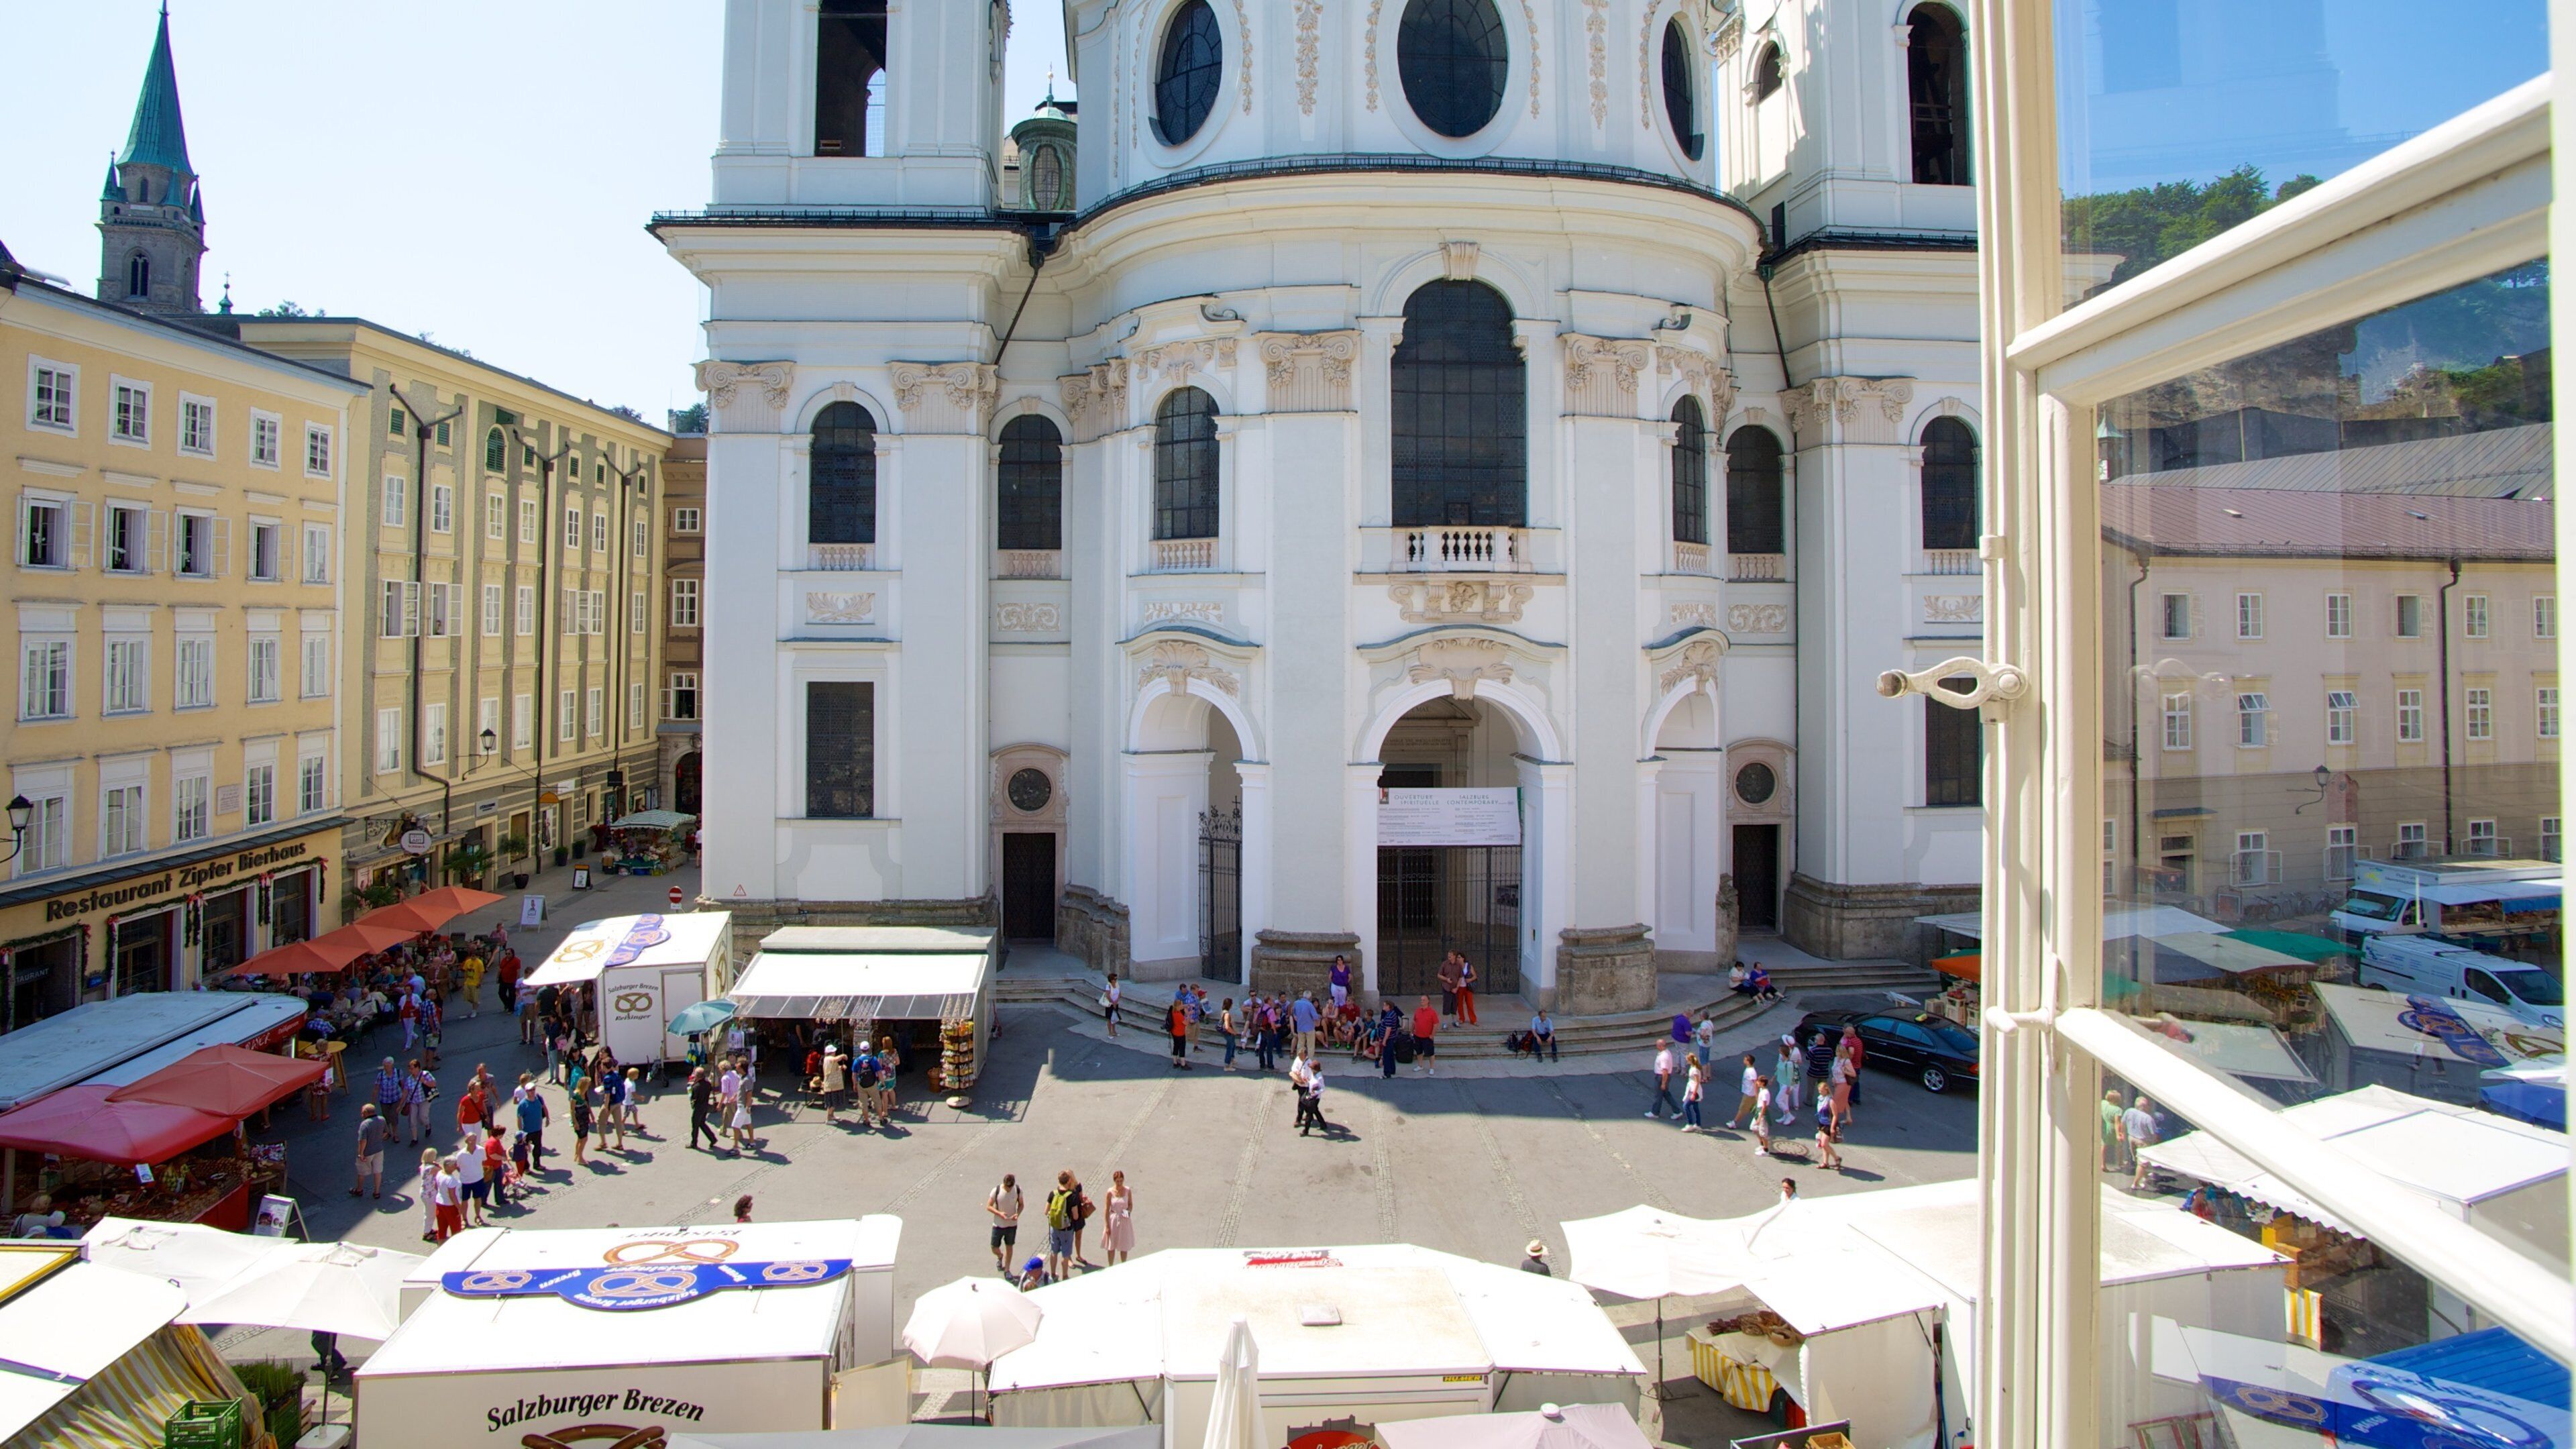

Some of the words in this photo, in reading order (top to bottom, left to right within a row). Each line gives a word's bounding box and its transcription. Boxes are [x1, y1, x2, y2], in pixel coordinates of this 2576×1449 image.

[46, 873, 172, 922] Restaurant
[178, 859, 233, 888] Zipfer
[237, 843, 307, 871] Bierhaus
[608, 984, 639, 993] Salzburger
[639, 983, 659, 991] Brezen
[539, 1269, 582, 1289] Brezen
[616, 1288, 699, 1307] Salzburger
[487, 1393, 619, 1432] Salzburger
[623, 1389, 704, 1421] Brezen
